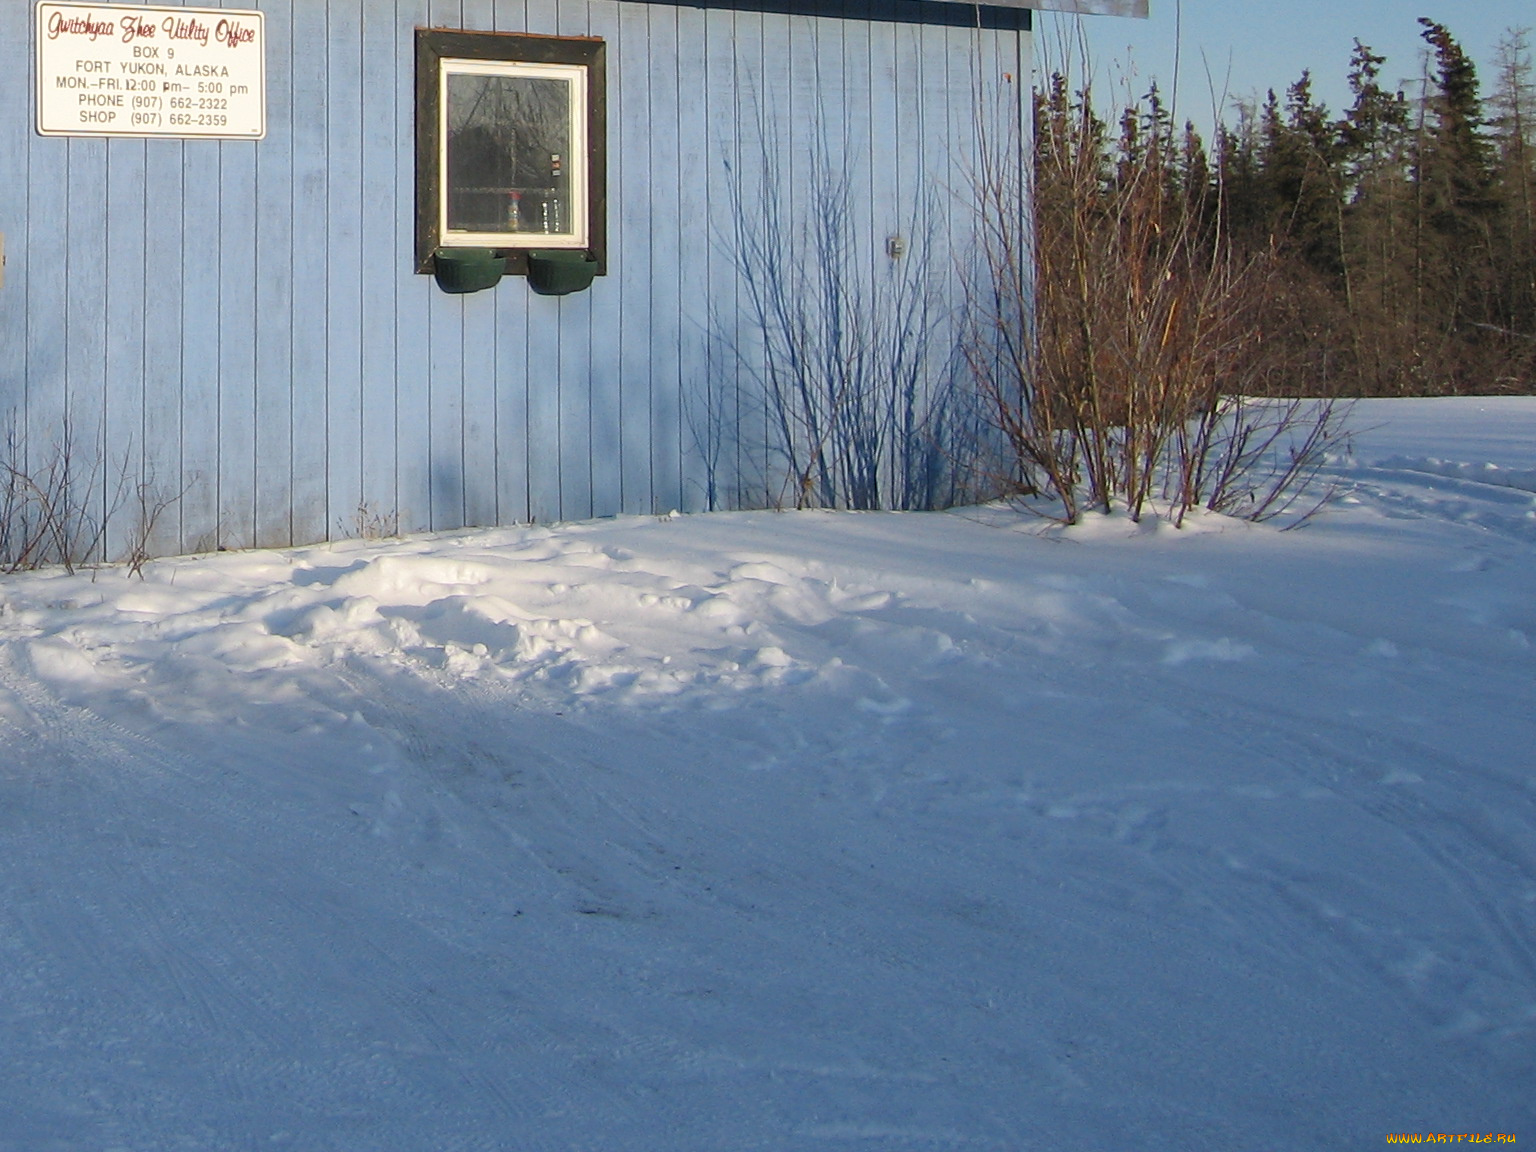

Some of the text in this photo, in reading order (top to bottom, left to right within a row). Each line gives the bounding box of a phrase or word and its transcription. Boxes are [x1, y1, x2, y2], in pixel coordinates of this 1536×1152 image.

[120, 16, 156, 43] Zhee
[161, 16, 209, 47] Utility
[215, 19, 255, 48] Office
[133, 46, 175, 60] BOX 9
[76, 60, 229, 78] FORT YUKON, ALASKA
[197, 81, 223, 94] 5:00
[229, 84, 249, 97] pm
[78, 94, 228, 111] PHONE (907) 662-2322
[79, 111, 227, 127] SHOP (907) 662-2359
